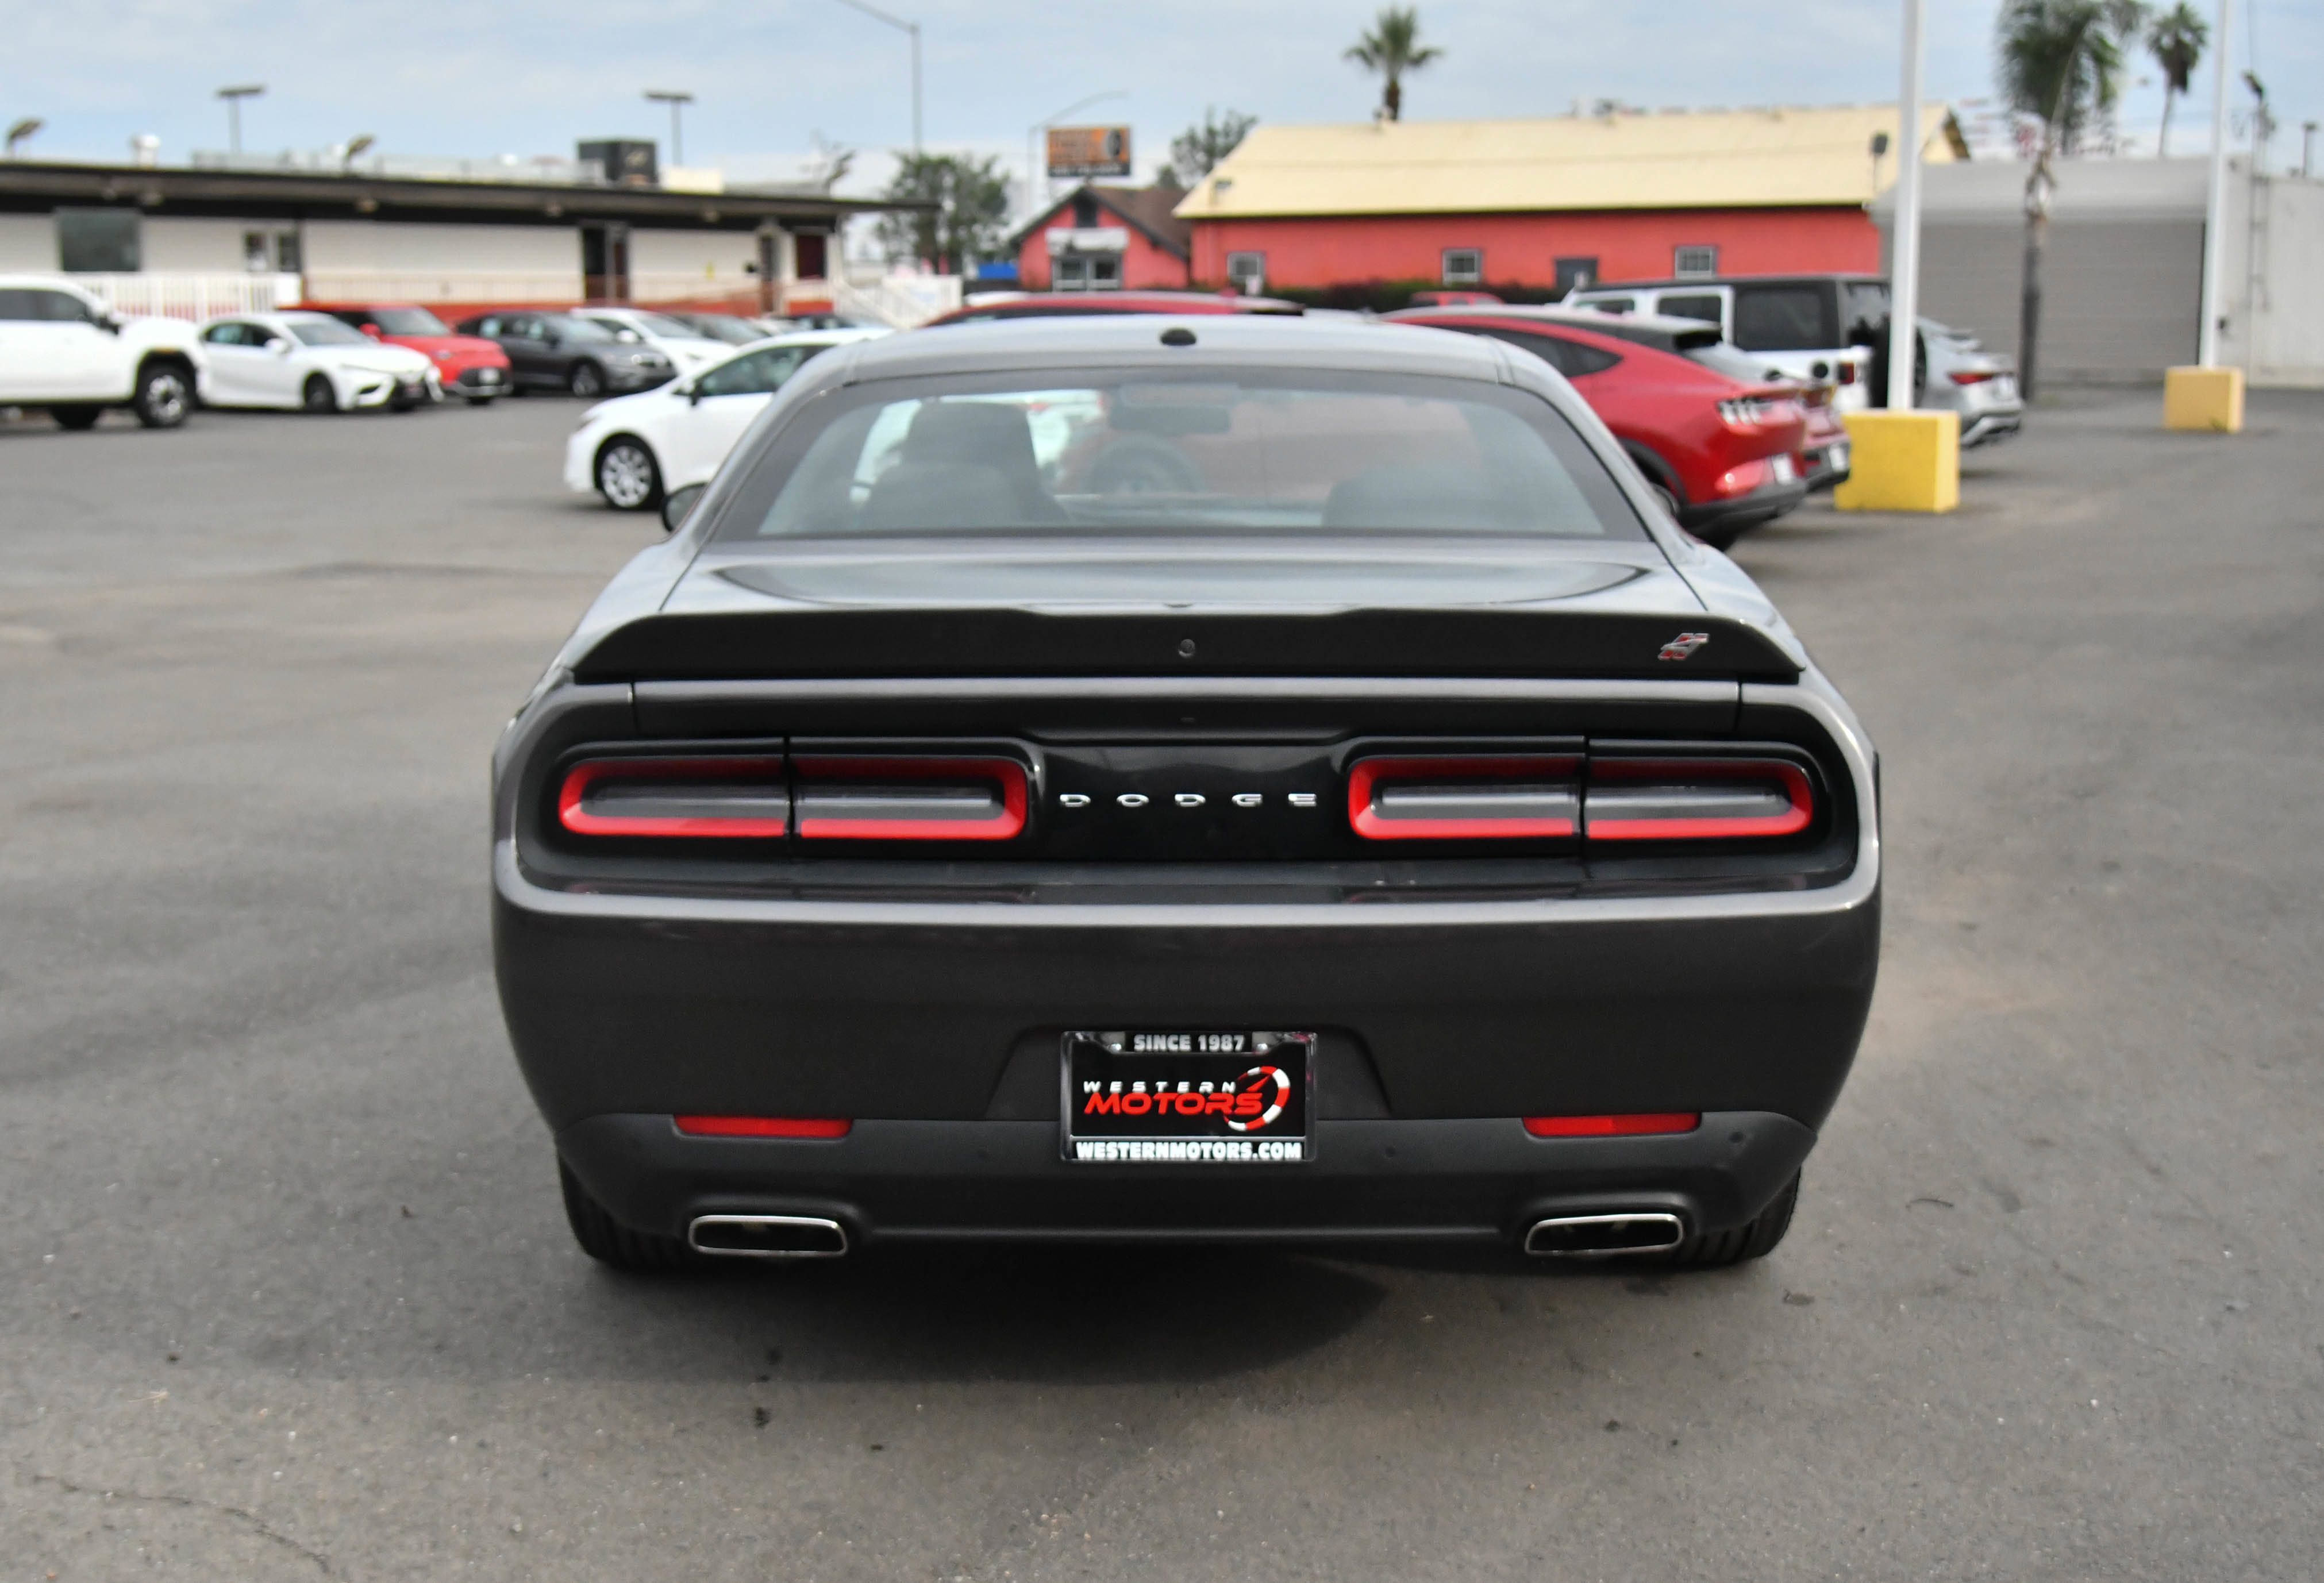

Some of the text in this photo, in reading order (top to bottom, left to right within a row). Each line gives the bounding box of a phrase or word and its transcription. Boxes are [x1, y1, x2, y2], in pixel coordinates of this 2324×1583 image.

[1059, 794, 1317, 807] DODGE
[1134, 1034, 1245, 1052] SINCE 1987
[1083, 1081, 1236, 1092] WESTERN
[1084, 1092, 1263, 1115] MOTORS
[1076, 1142, 1302, 1160] WESTERNMOTORS.COM
